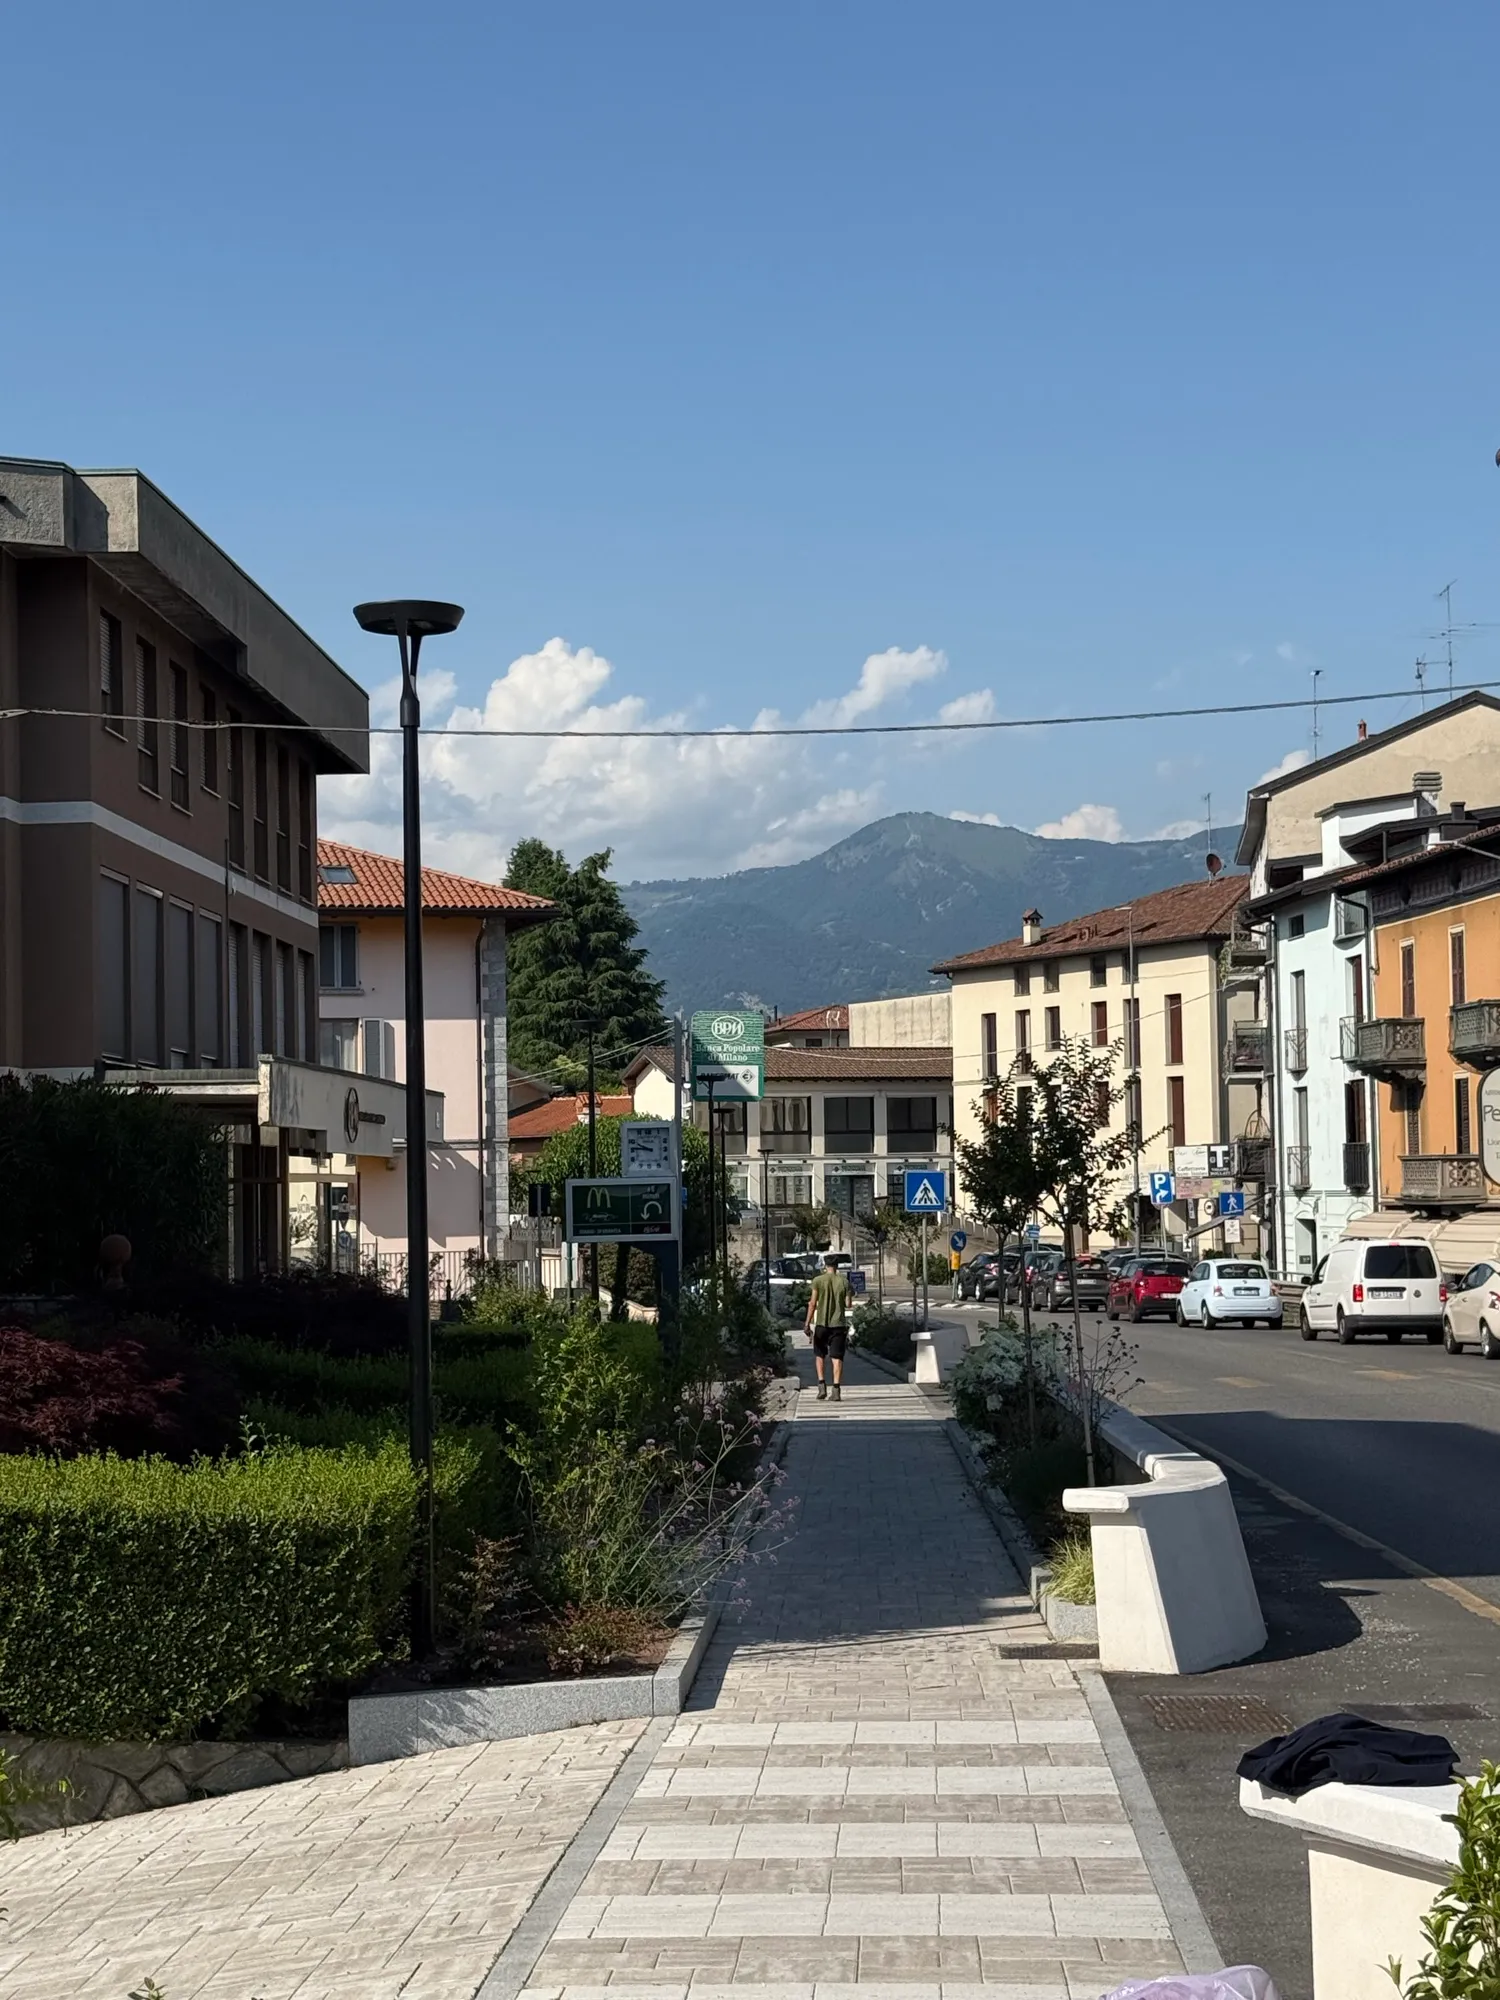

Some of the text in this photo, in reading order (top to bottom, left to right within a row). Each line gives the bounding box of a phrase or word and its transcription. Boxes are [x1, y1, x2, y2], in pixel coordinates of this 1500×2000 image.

[696, 1043, 761, 1054] Banca Popolare
[708, 1052, 748, 1061] di Milano
[1153, 1174, 1166, 1190] P
